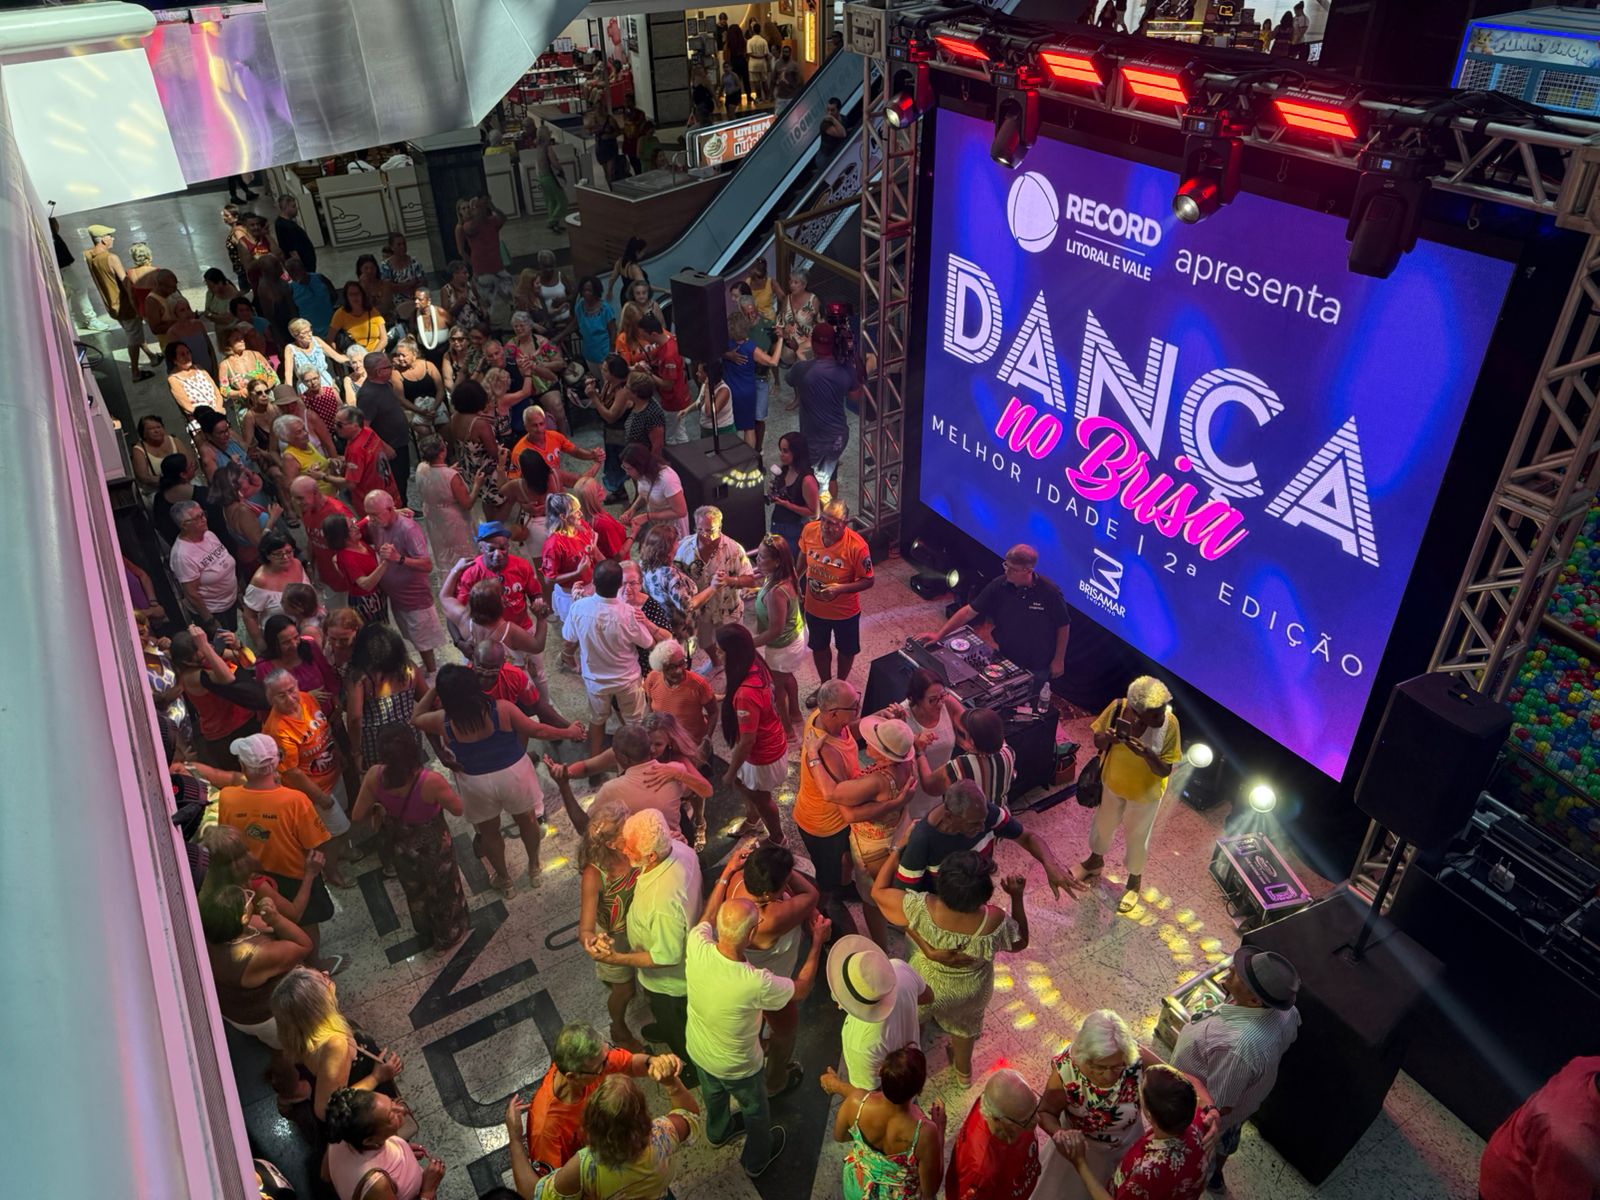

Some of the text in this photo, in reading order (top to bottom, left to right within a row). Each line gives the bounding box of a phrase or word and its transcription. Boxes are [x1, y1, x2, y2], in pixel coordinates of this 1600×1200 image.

[1066, 193, 1162, 247] RECORD
[1066, 238, 1152, 282] LITORAL E VALE
[1175, 245, 1342, 325] apresenta
[943, 252, 1380, 568] DANÇA
[995, 396, 1250, 561] no Brisa
[932, 415, 1021, 483] MELHOR
[1036, 477, 1120, 540] IDADE
[1218, 581, 1363, 676] EDIÇÃO
[1079, 579, 1126, 618] BRISAMAR
